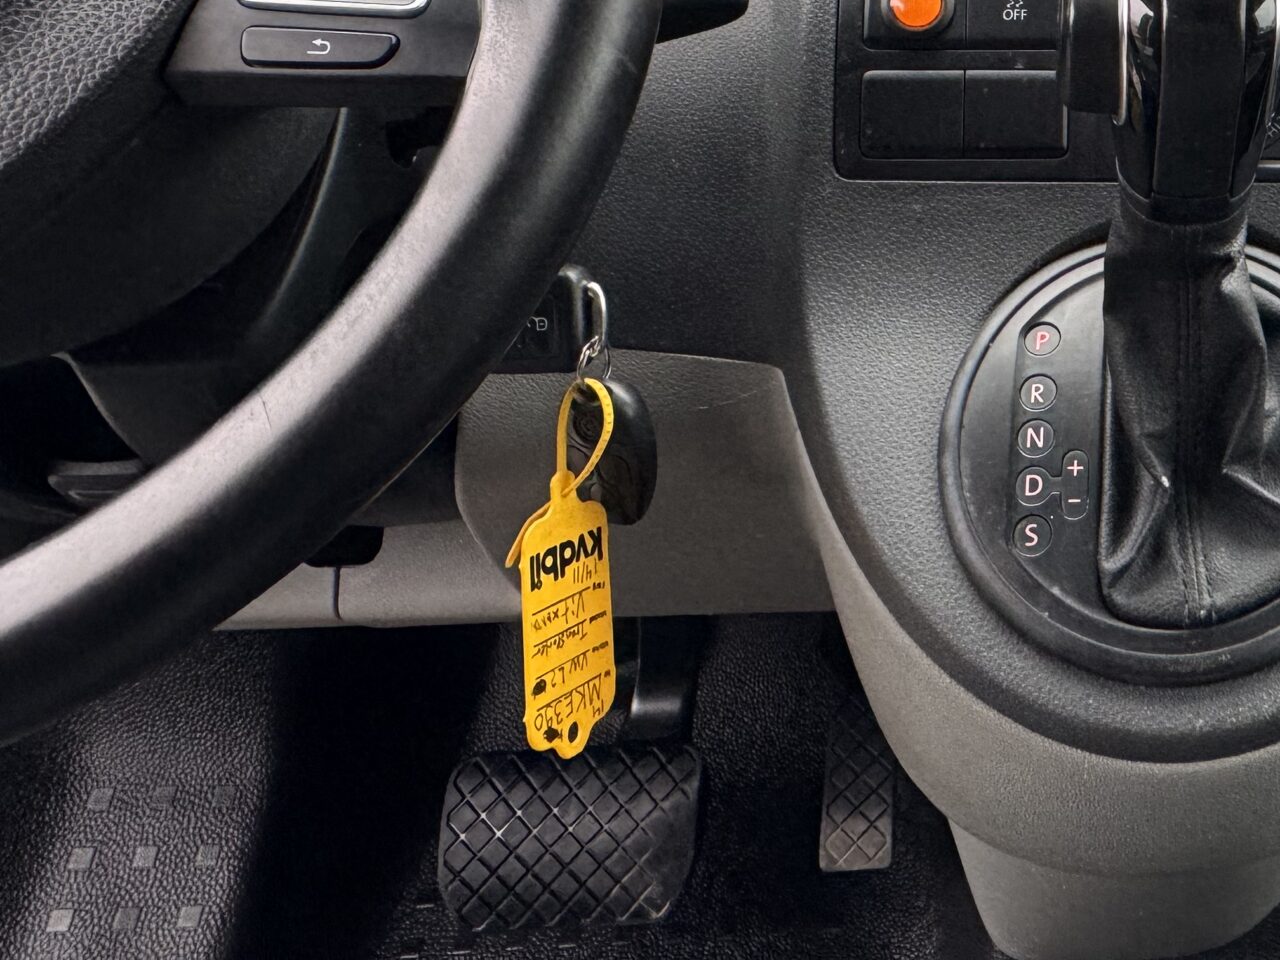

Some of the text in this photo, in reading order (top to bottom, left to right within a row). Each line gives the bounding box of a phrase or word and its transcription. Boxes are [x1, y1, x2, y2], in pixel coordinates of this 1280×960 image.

[1002, 8, 1028, 22] OFF
[1035, 331, 1050, 351] P
[1030, 383, 1044, 404] R
[1026, 426, 1045, 449] N
[1024, 474, 1044, 497] D
[1024, 523, 1039, 547] S
[530, 526, 604, 592] kvdbil
